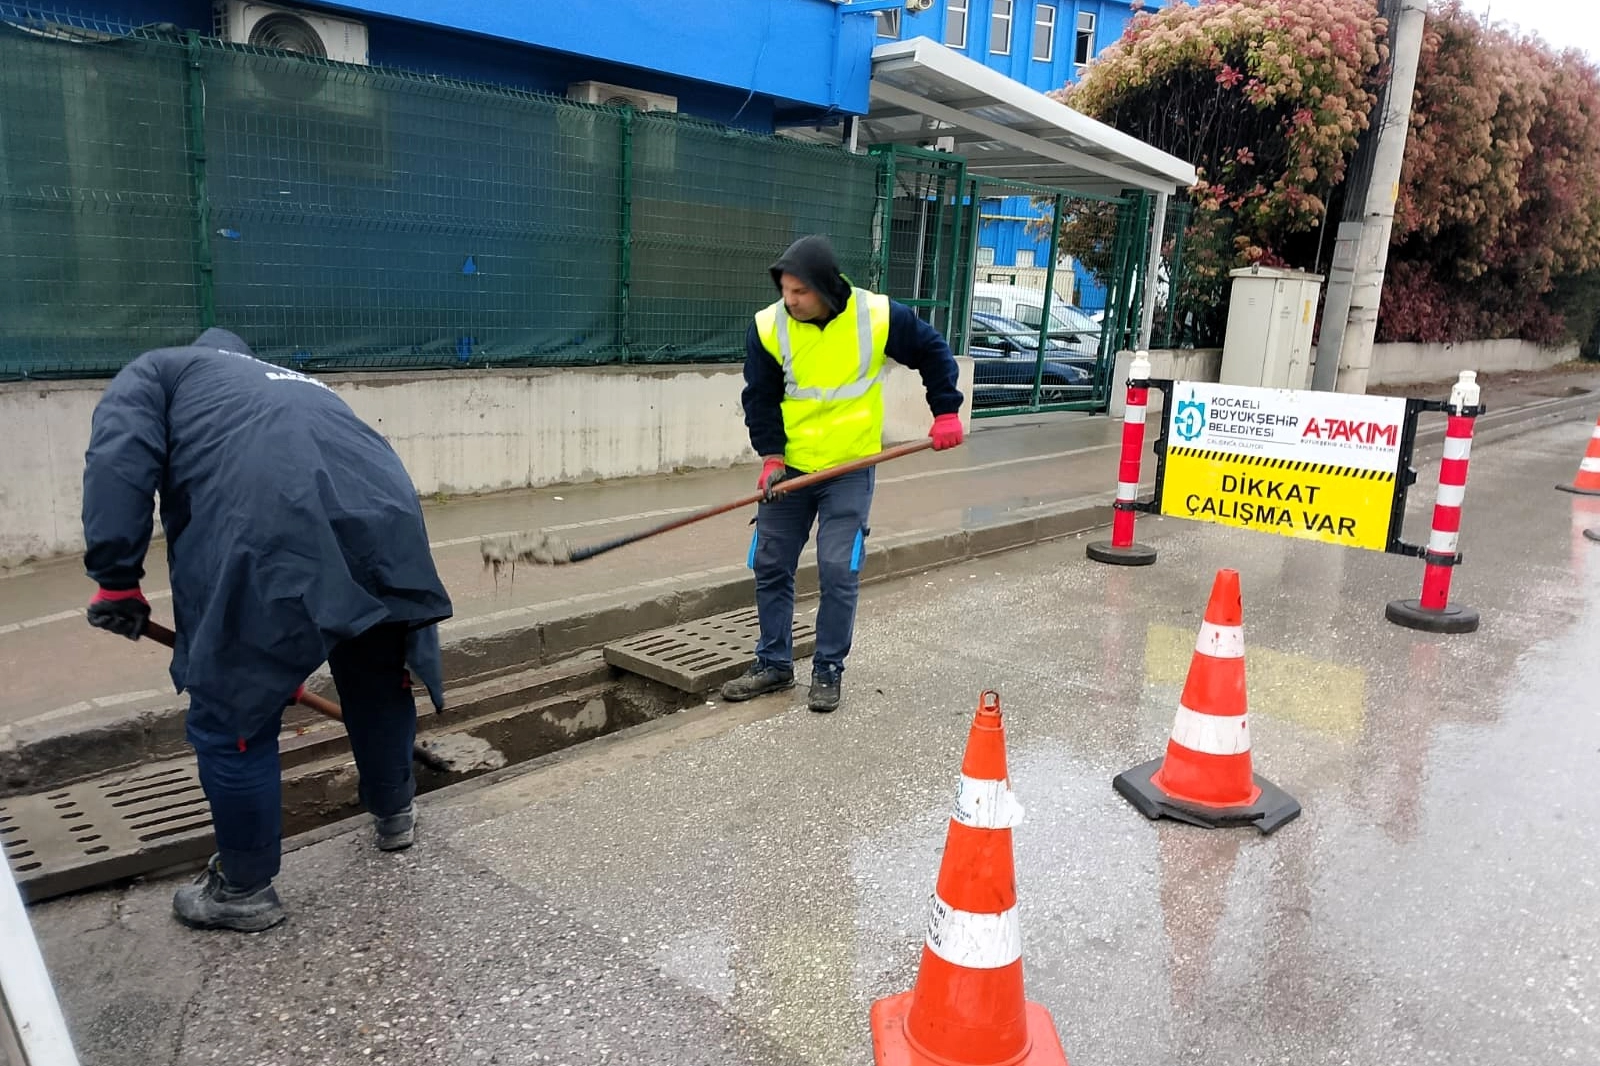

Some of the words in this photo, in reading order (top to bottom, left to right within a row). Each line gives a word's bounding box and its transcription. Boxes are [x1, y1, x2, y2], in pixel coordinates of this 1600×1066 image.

[1208, 422, 1274, 438] BELEDİYESİ
[1210, 408, 1299, 427] BÜYÜKŞEHİR
[1302, 417, 1398, 446] A-TAKIMI
[1221, 472, 1321, 505] DİKKAT
[1186, 494, 1294, 528] ÇALIŞMA
[1303, 511, 1357, 537] VAR
